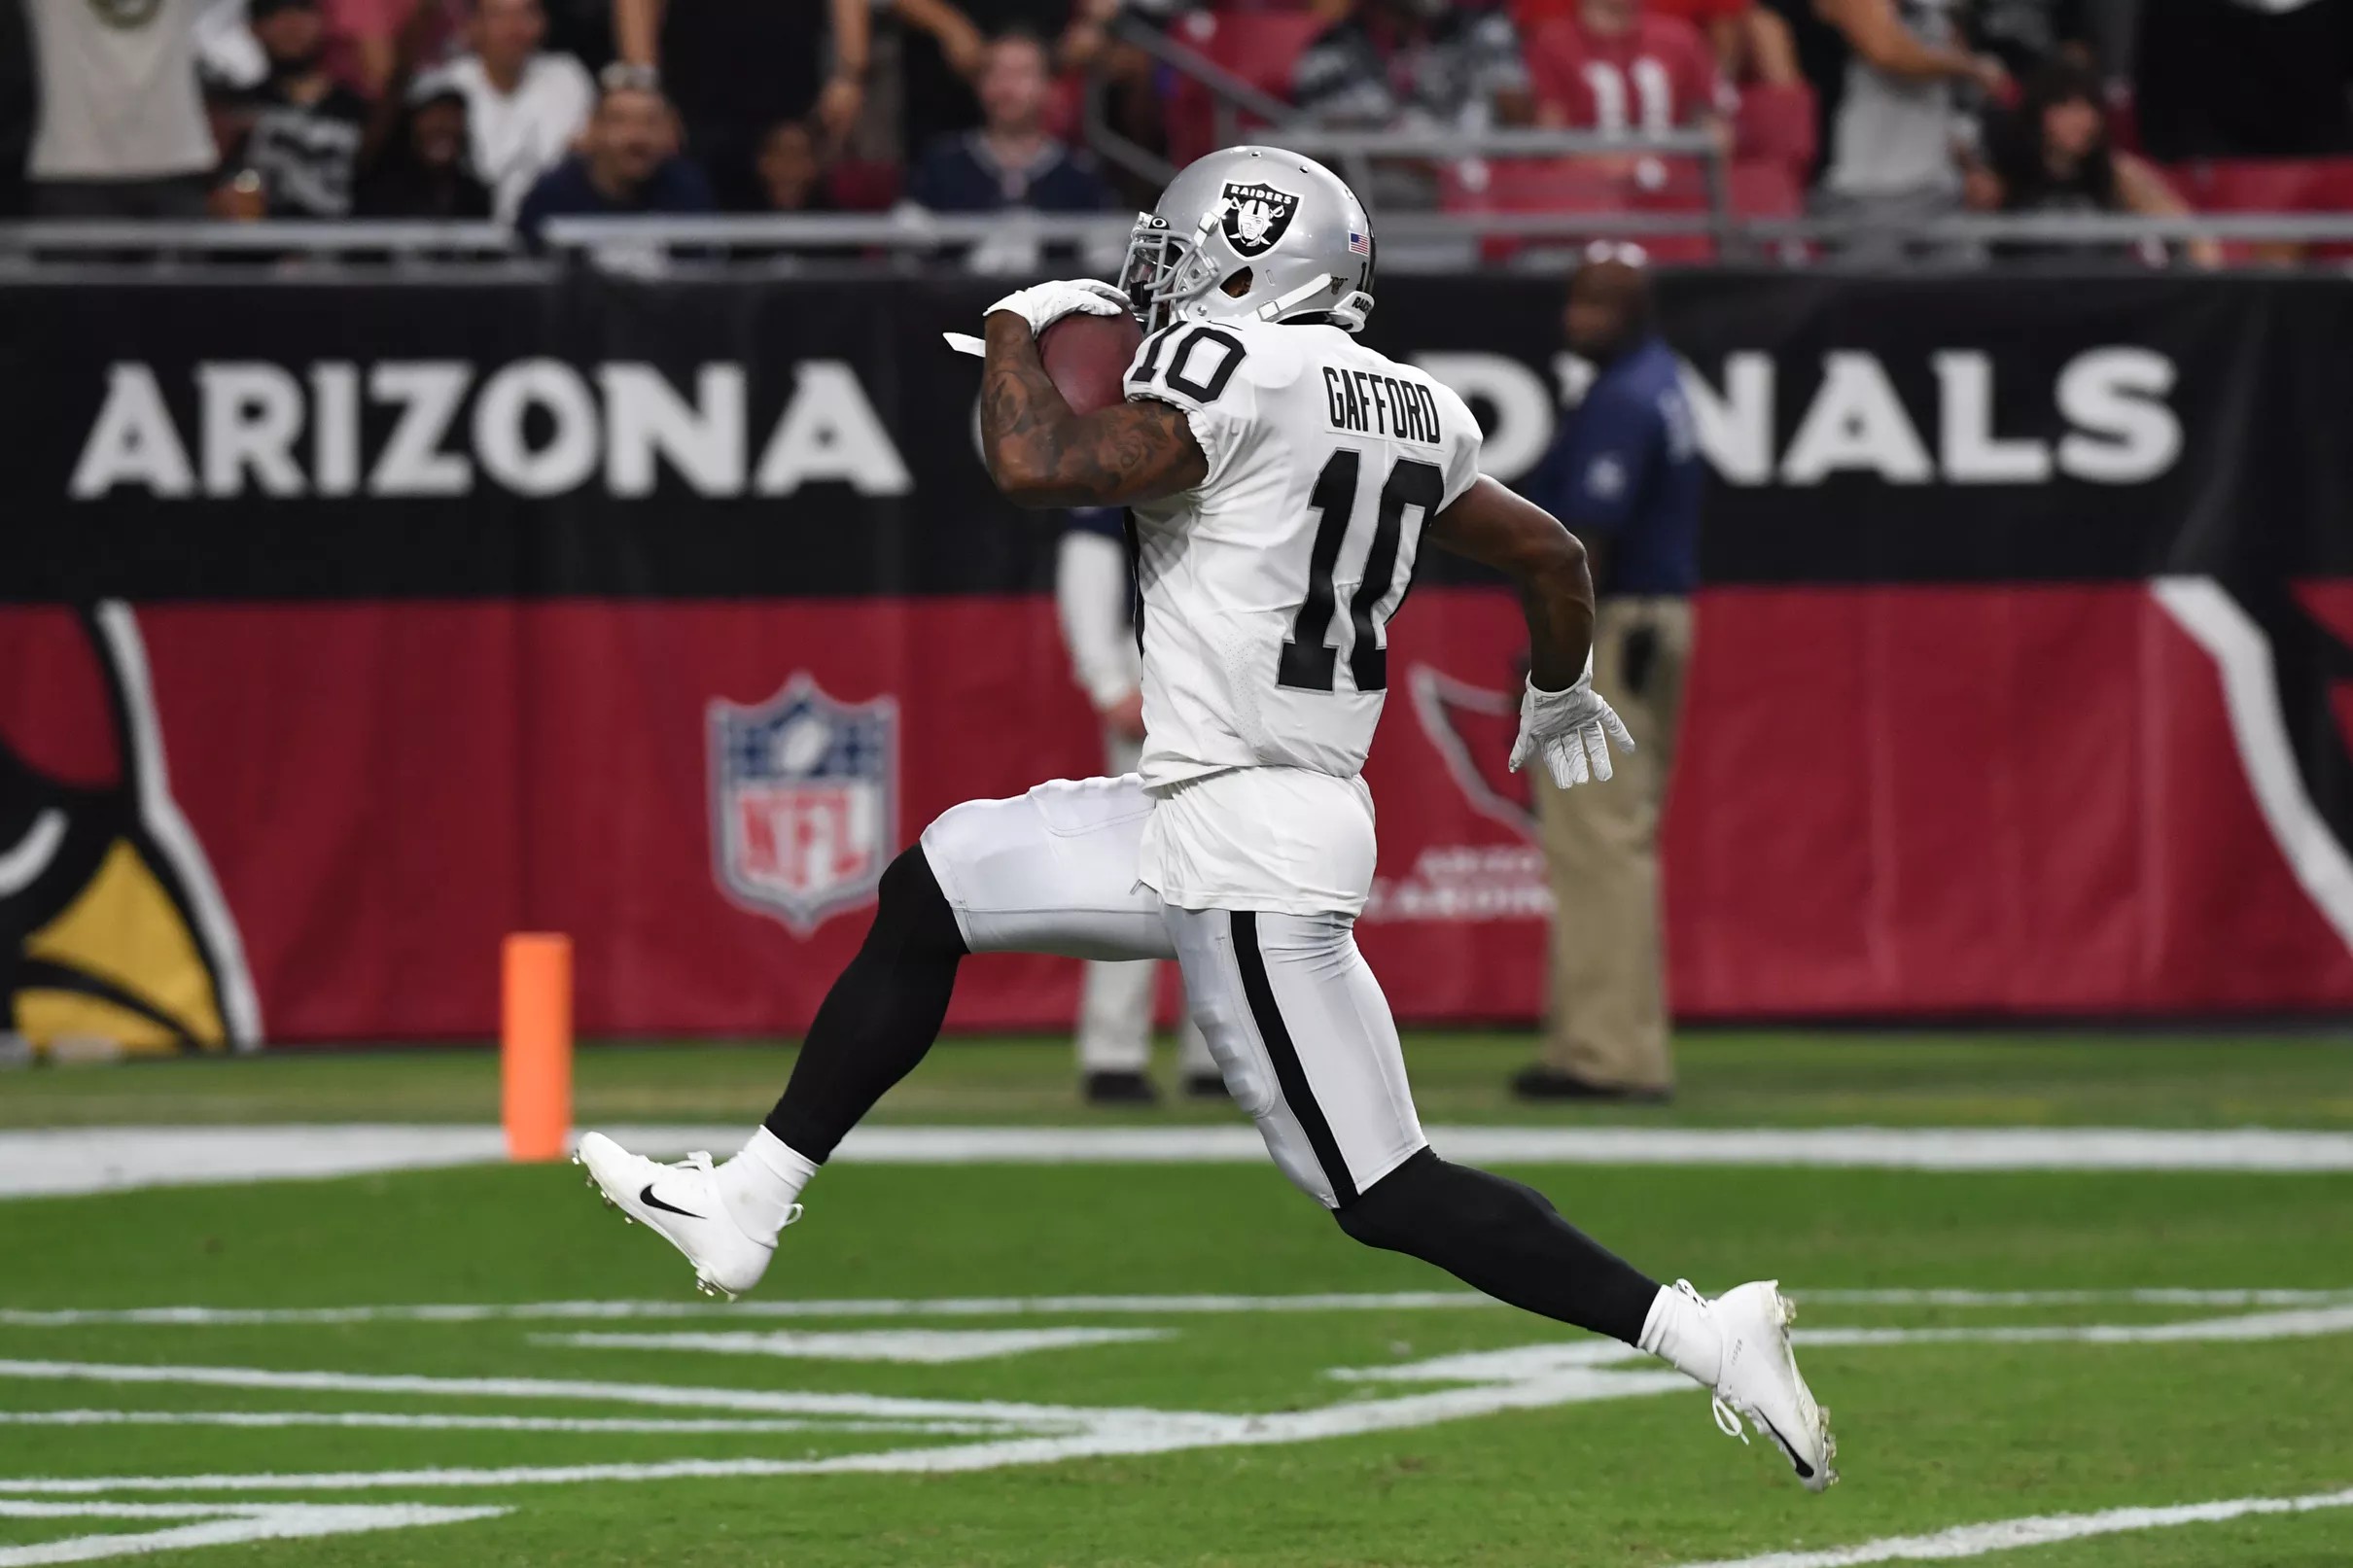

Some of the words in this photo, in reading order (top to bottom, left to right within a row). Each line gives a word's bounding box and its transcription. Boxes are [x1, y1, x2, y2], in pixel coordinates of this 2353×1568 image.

[1230, 185, 1293, 204] RAIDERS
[1130, 320, 1247, 404] 10
[1322, 366, 1442, 444] GAFFORD
[70, 359, 913, 499] ARIZONA
[1275, 446, 1446, 694] 10
[739, 789, 871, 887] NFL
